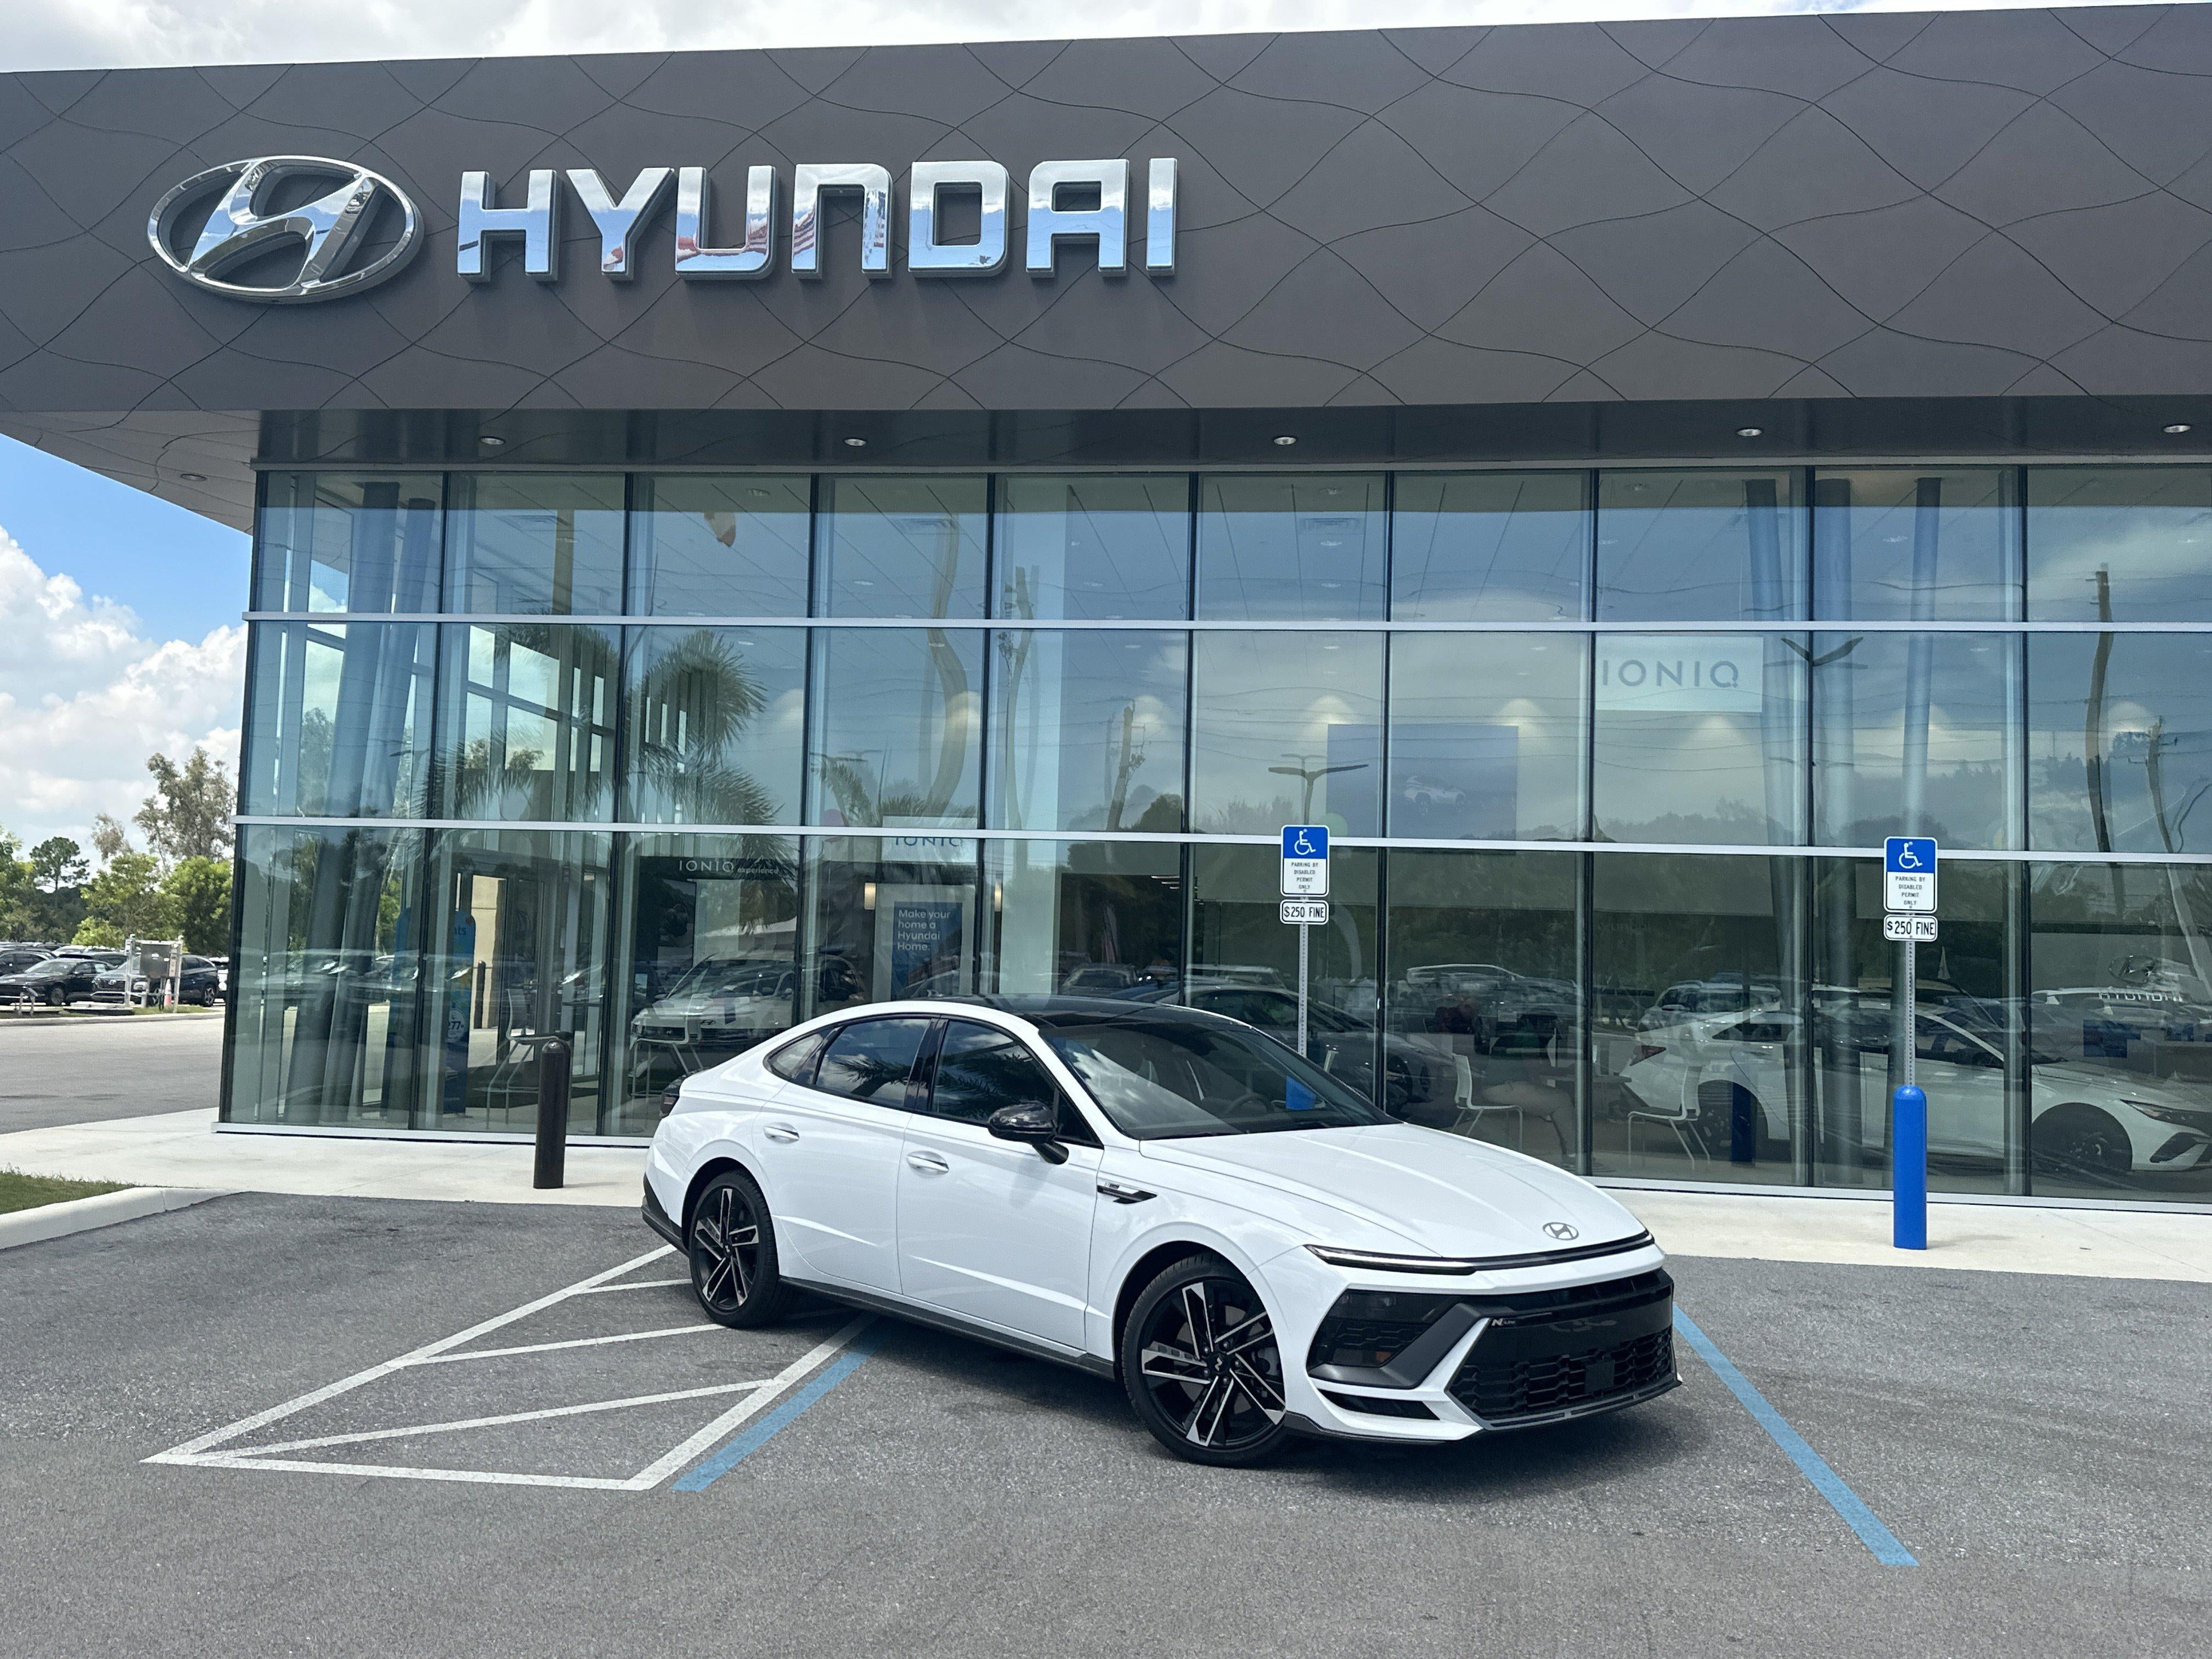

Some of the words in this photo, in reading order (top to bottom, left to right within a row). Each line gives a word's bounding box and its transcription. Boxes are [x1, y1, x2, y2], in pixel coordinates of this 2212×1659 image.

[458, 158, 1177, 278] HYUNDAI
[1602, 659, 1739, 687] IONIQ
[679, 860, 734, 872] IONIQ
[899, 910, 926, 918] Make
[928, 911, 951, 921] your
[1284, 906, 1305, 917] $250
[1309, 907, 1324, 918] FINE
[898, 920, 927, 929] home
[1887, 921, 1912, 934] $250
[1916, 922, 1936, 935] FINE
[898, 931, 940, 941] Hyundai
